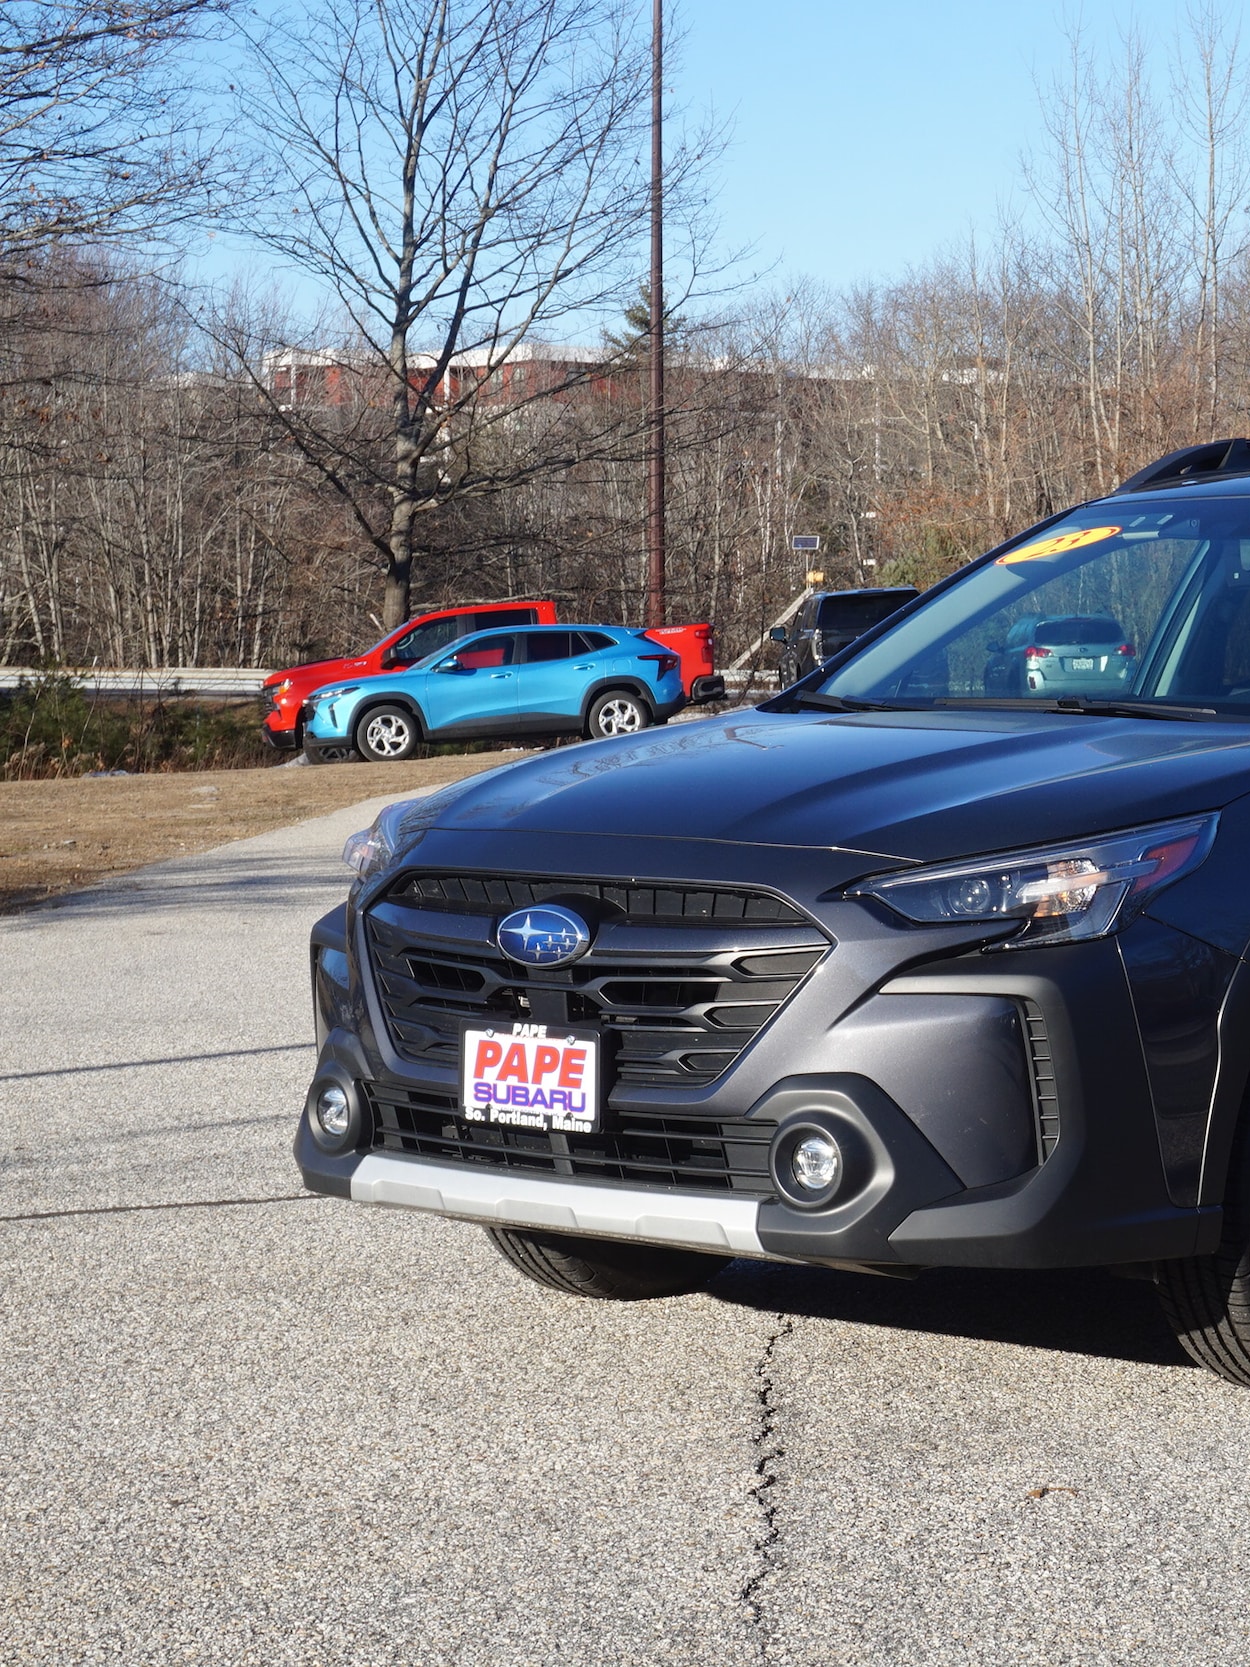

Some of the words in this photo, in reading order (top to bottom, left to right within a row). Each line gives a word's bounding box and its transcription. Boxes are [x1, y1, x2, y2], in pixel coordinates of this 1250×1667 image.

[512, 1022, 547, 1038] PAPE
[473, 1040, 587, 1089] PAPE
[473, 1081, 586, 1113] SUBARU
[465, 1106, 485, 1121] So.
[490, 1108, 547, 1131] Portland,
[552, 1114, 592, 1133] Maine
